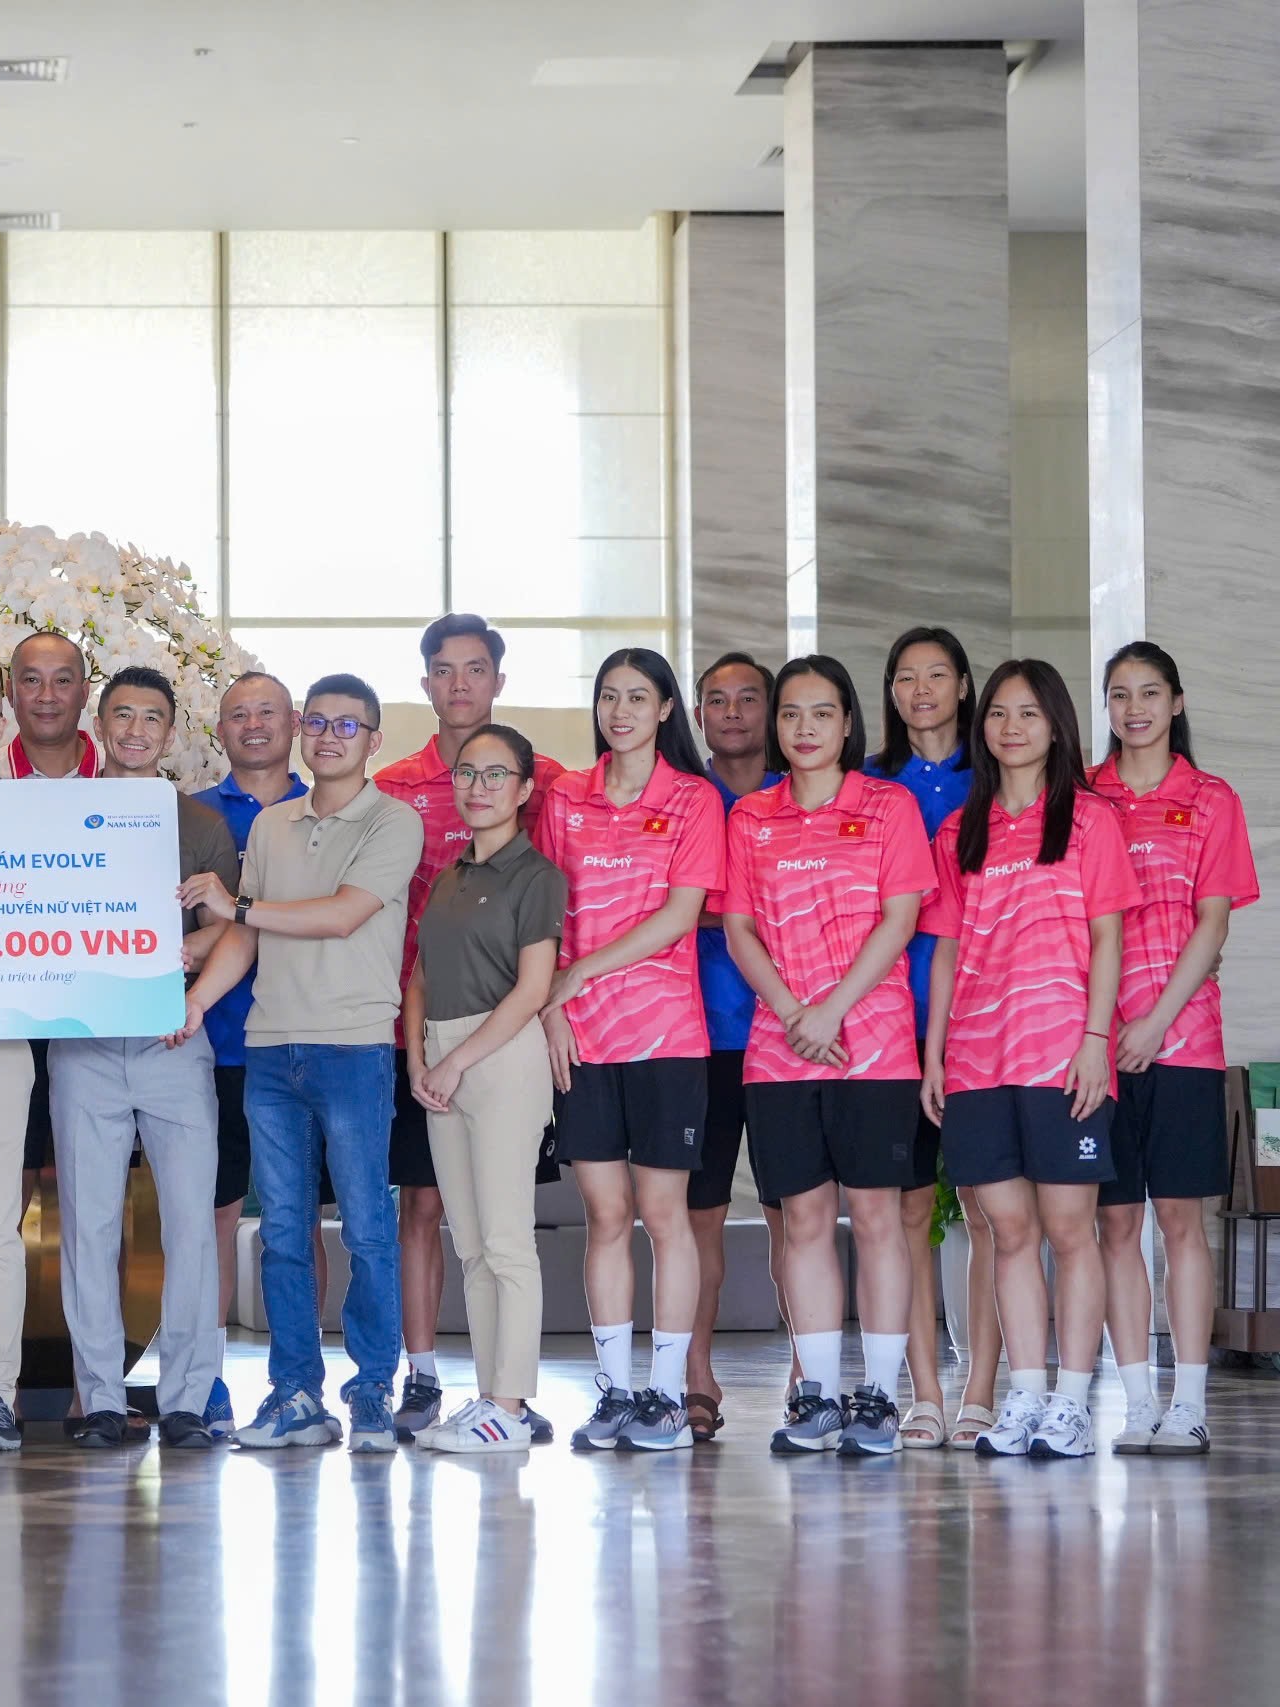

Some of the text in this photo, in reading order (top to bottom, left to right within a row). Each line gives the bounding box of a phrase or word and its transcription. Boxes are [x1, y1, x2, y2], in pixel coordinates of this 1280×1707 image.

[142, 820, 161, 828] GÒN
[445, 831, 473, 842] PHU
[31, 852, 107, 869] EVOLVE
[47, 900, 69, 914] NỮ
[71, 899, 102, 916] VIỆT
[105, 902, 137, 913] NAM
[80, 929, 158, 956] VNĐ
